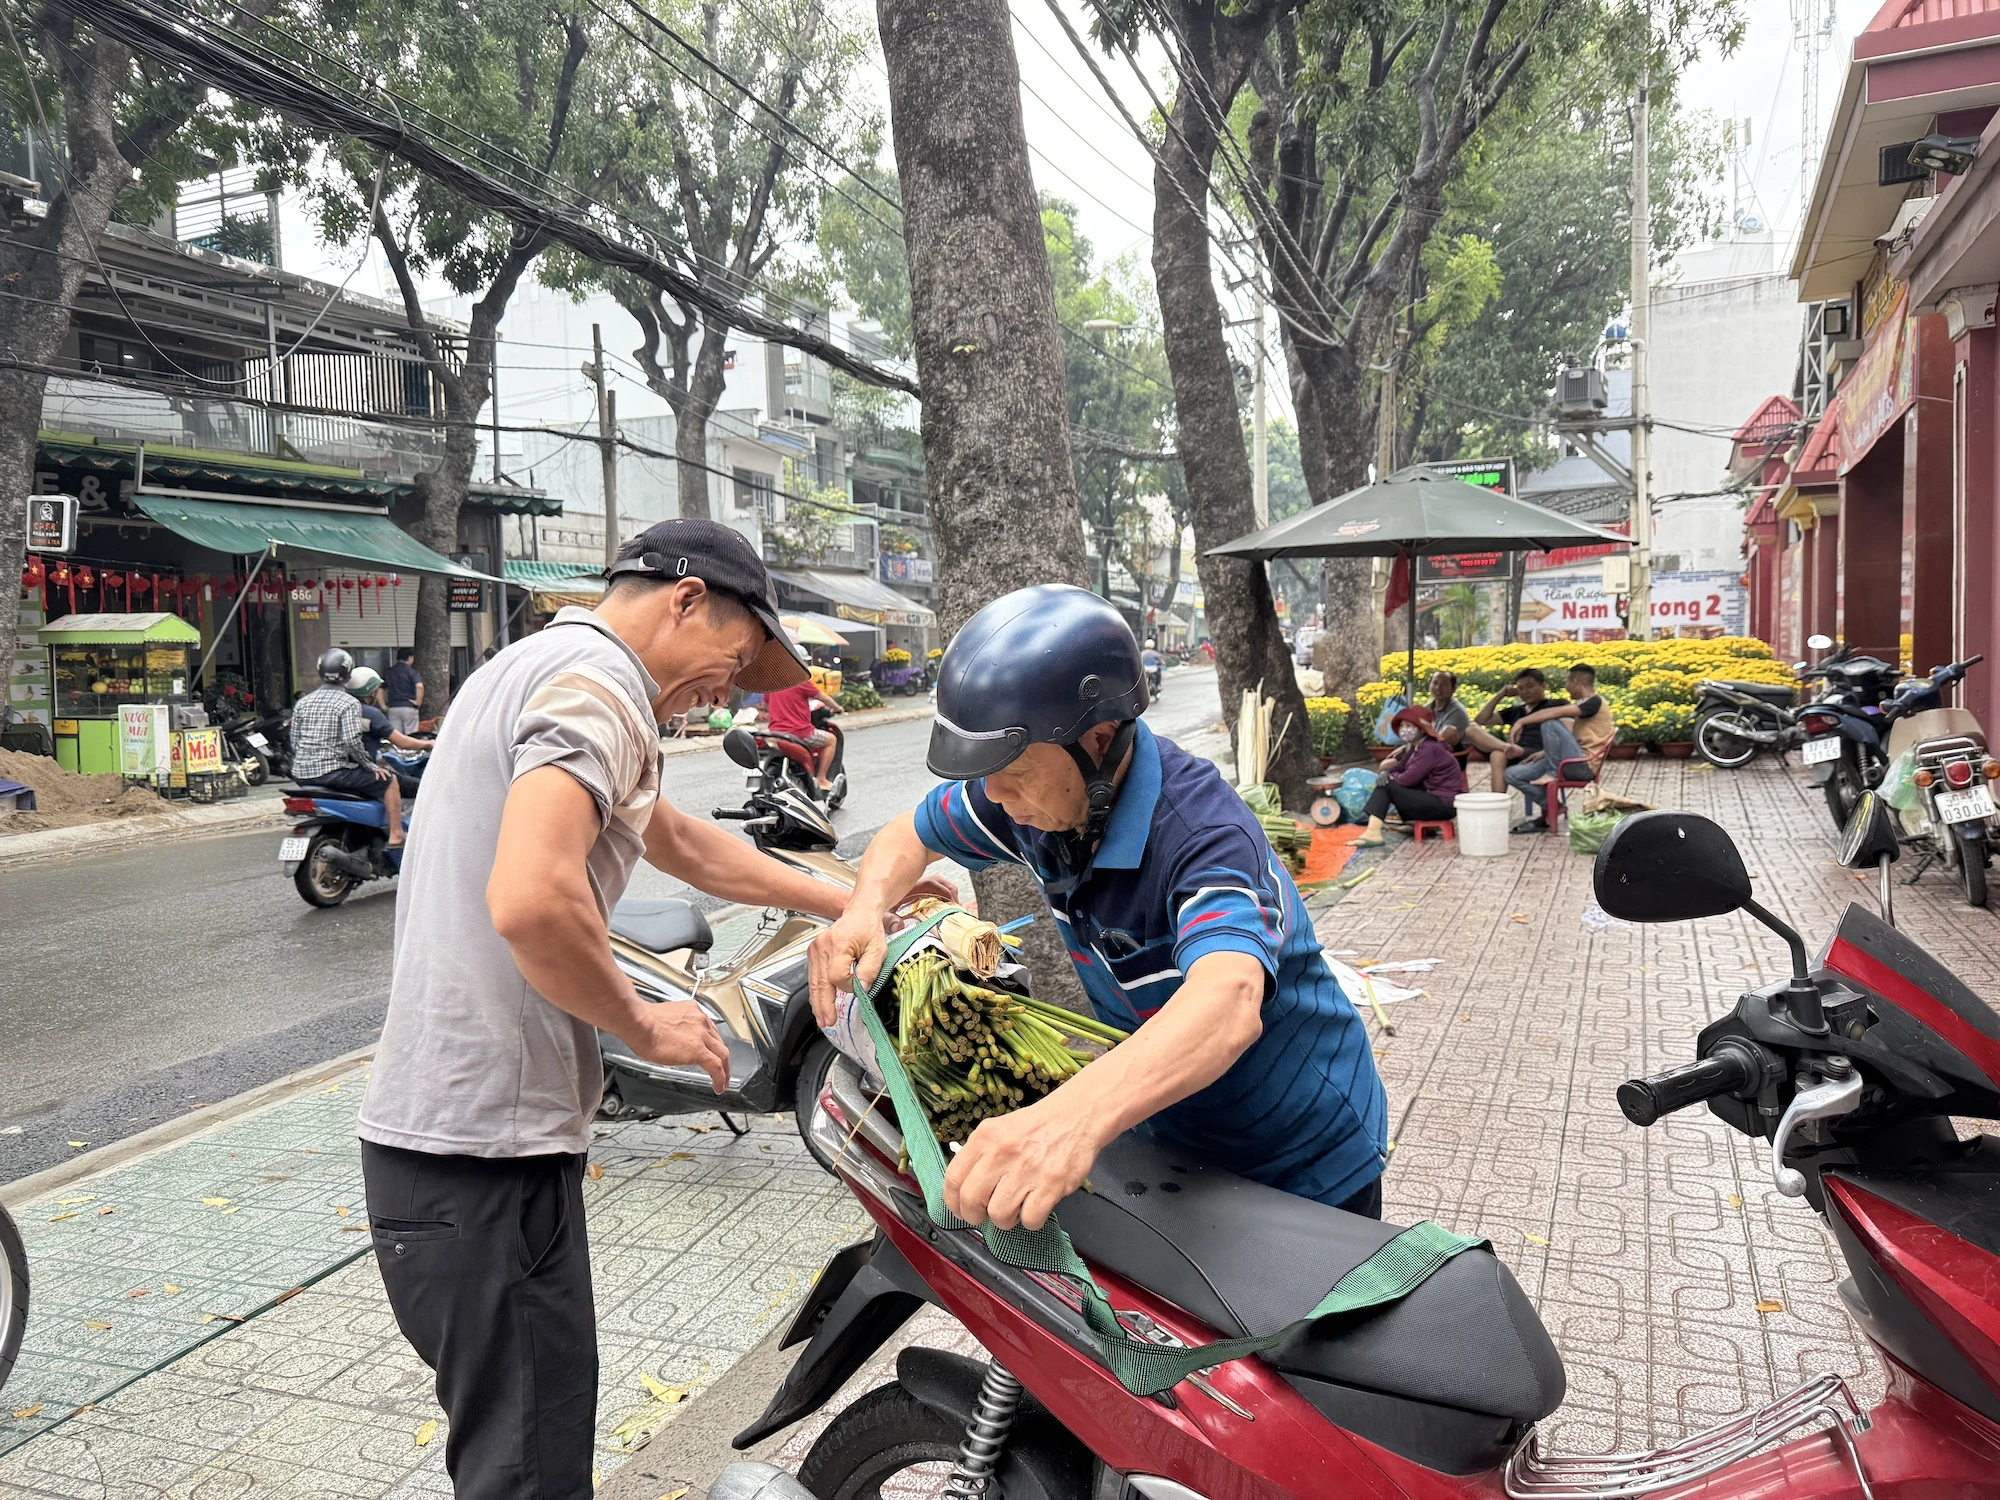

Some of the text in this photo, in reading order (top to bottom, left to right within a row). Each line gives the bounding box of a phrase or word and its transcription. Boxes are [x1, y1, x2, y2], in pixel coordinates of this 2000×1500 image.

[1562, 601, 1608, 619] Nam
[1706, 594, 1721, 616] 2
[122, 710, 152, 723] NƯỚC
[188, 739, 218, 761] Mía
[1944, 801, 1992, 821] 030.04
